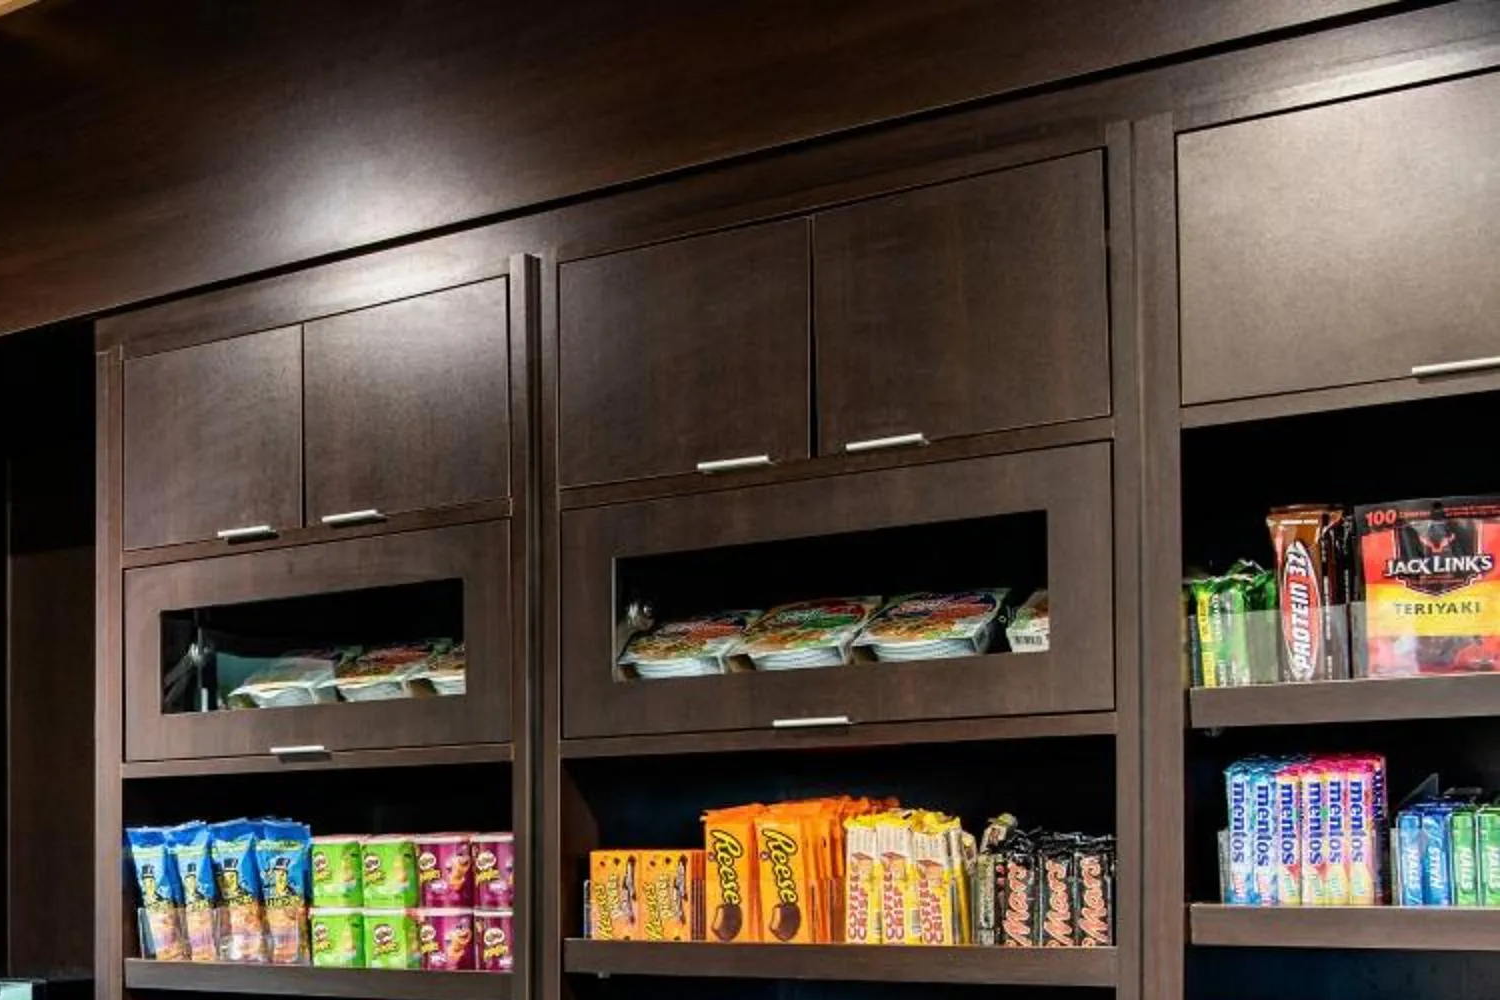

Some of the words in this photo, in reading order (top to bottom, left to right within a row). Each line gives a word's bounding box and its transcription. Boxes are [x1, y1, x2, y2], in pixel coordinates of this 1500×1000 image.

[1365, 510, 1397, 527] 100
[1384, 559, 1431, 577] JACK
[1395, 601, 1481, 616] TERIYAKI
[1231, 782, 1247, 864] mentos
[1256, 785, 1272, 867] mentos
[1281, 783, 1297, 865] mentos
[1309, 782, 1324, 865] mentos
[1329, 780, 1345, 864] mentos
[1350, 780, 1366, 864] mentos
[710, 829, 743, 905] Reese
[761, 828, 798, 905] Reese
